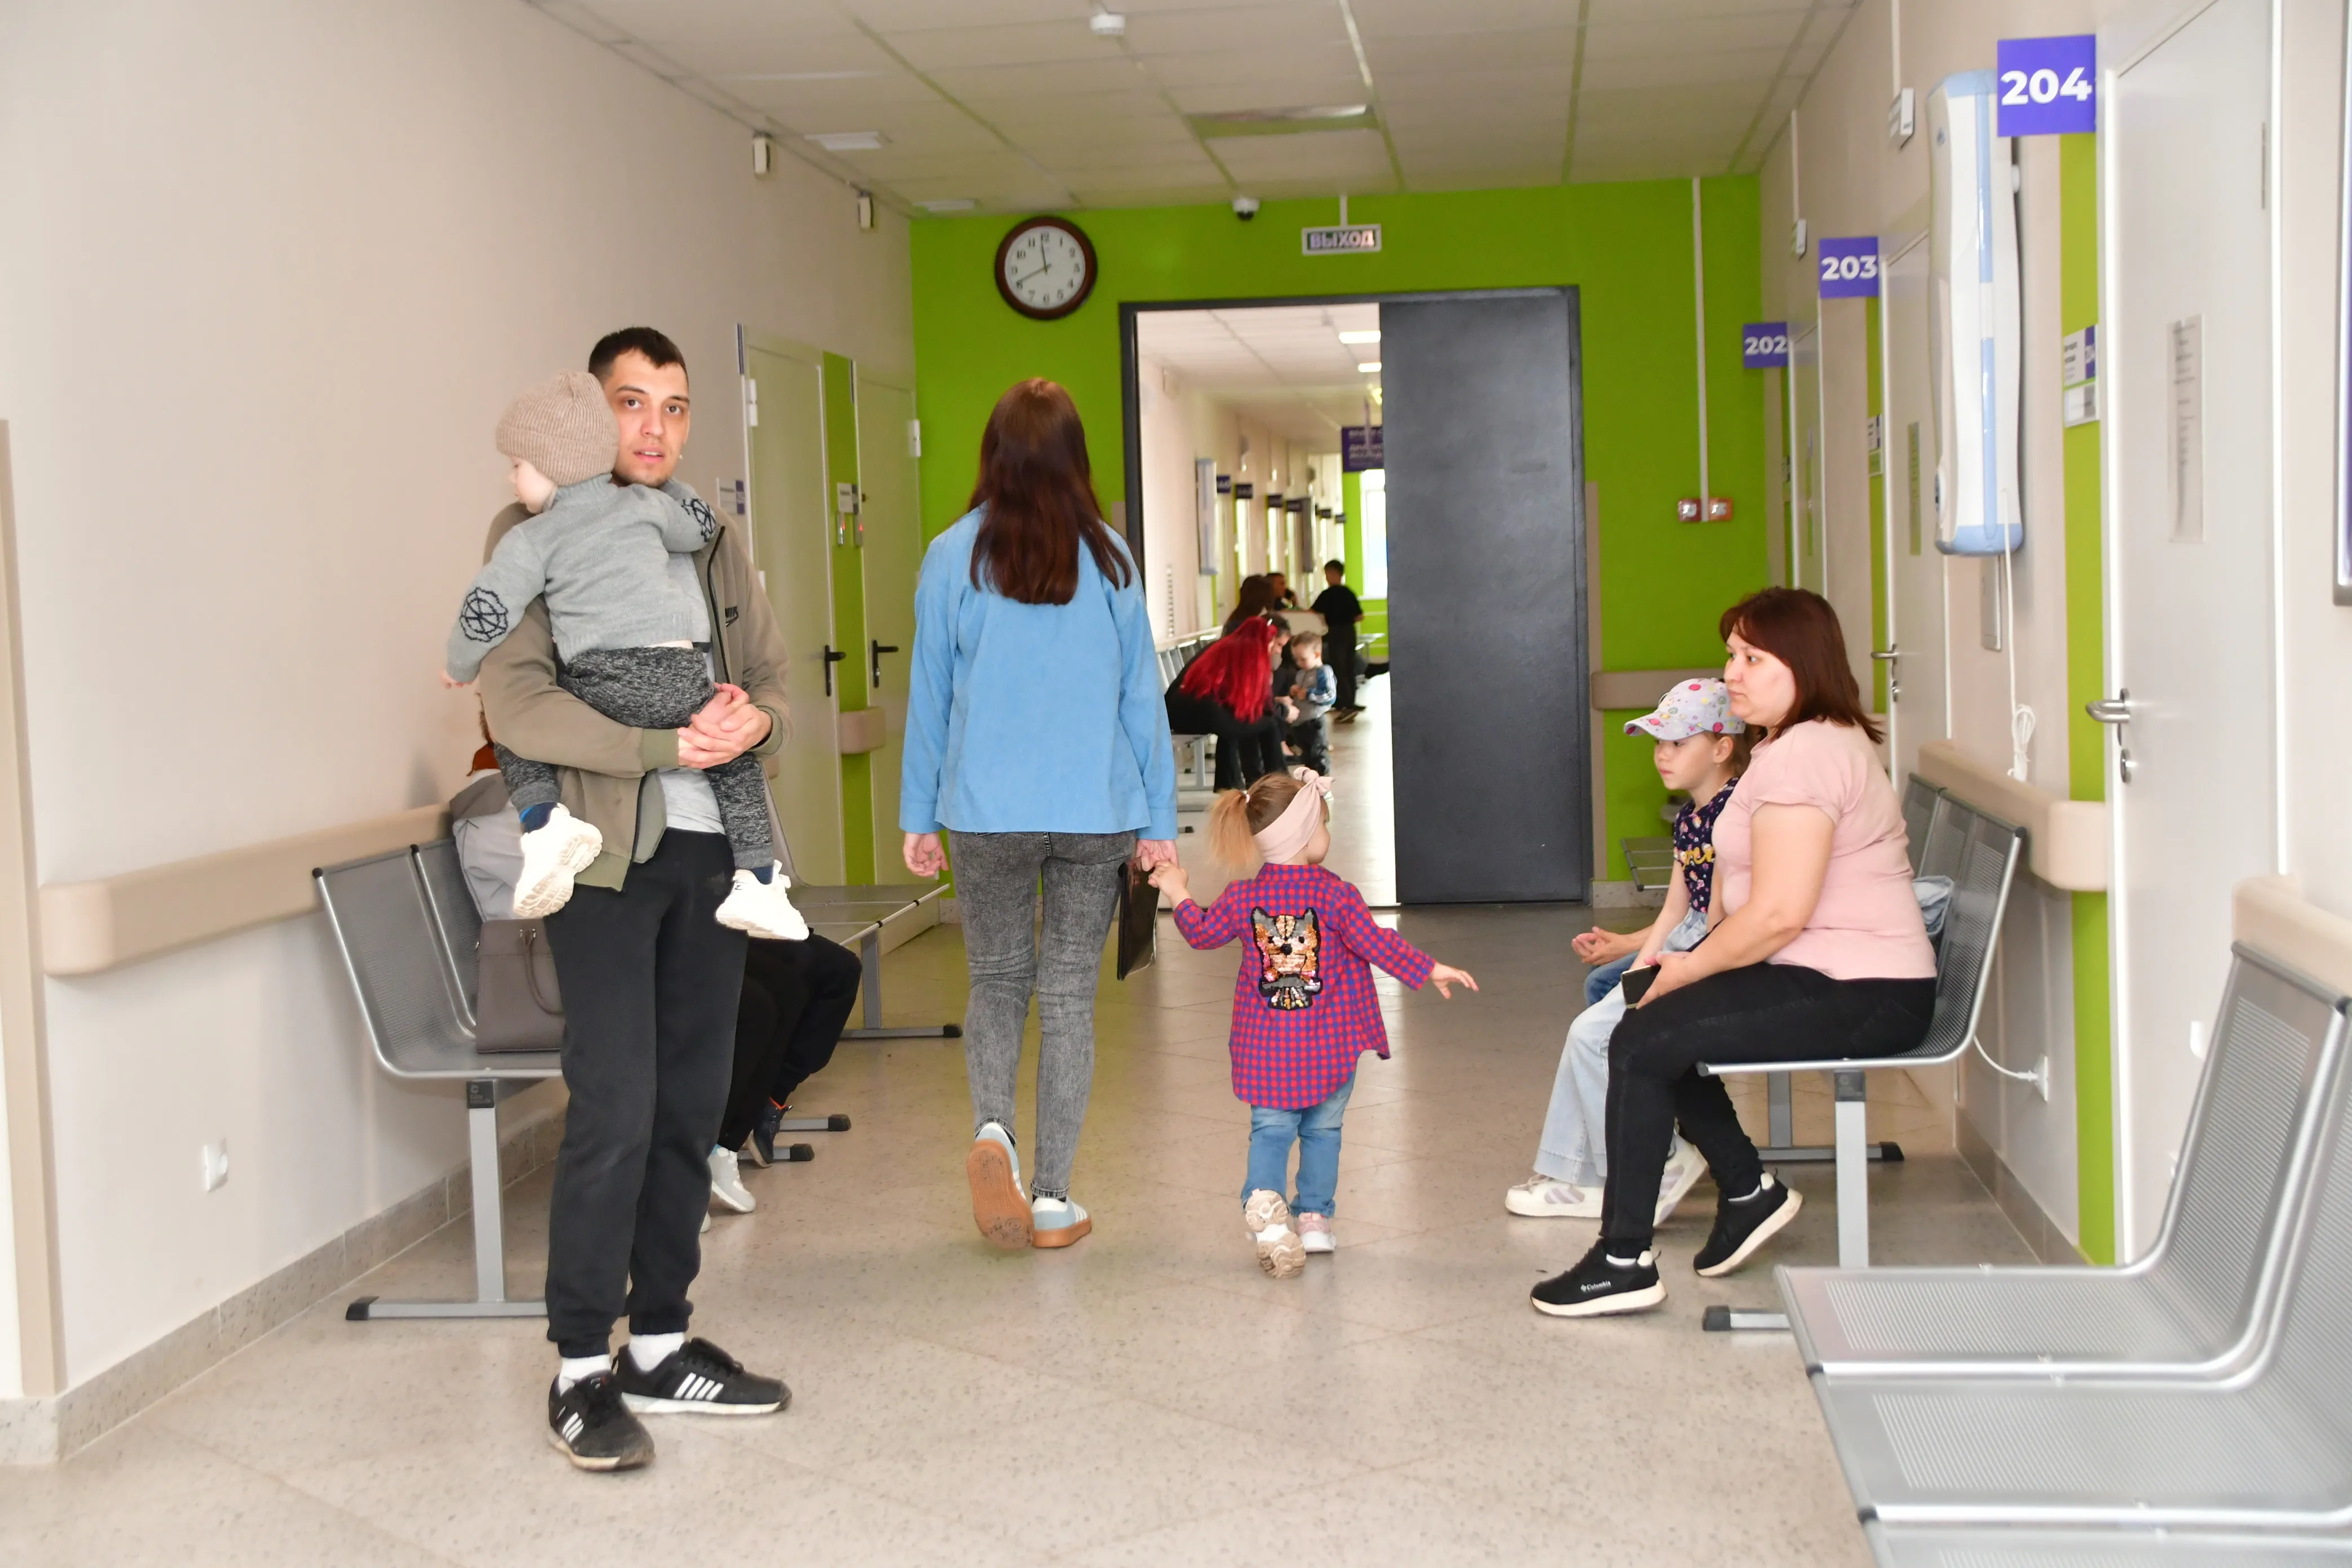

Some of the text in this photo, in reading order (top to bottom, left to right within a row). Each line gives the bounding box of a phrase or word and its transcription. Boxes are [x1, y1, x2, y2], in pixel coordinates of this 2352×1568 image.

[2001, 67, 2092, 106] 204
[1028, 237, 1035, 248] 11
[1059, 237, 1063, 248] 1
[1310, 230, 1374, 248] ВЫХОД
[1017, 250, 1026, 260] 10
[1070, 247, 1076, 259] 2
[1011, 265, 1018, 275] 9
[1074, 263, 1080, 274] 3
[1820, 255, 1878, 281] 203
[1067, 278, 1073, 289] 4
[1028, 289, 1035, 302] 7
[1043, 293, 1050, 305] 6
[1057, 288, 1064, 300] 5
[1744, 335, 1788, 356] 202
[1586, 1280, 1612, 1291] Columbia
